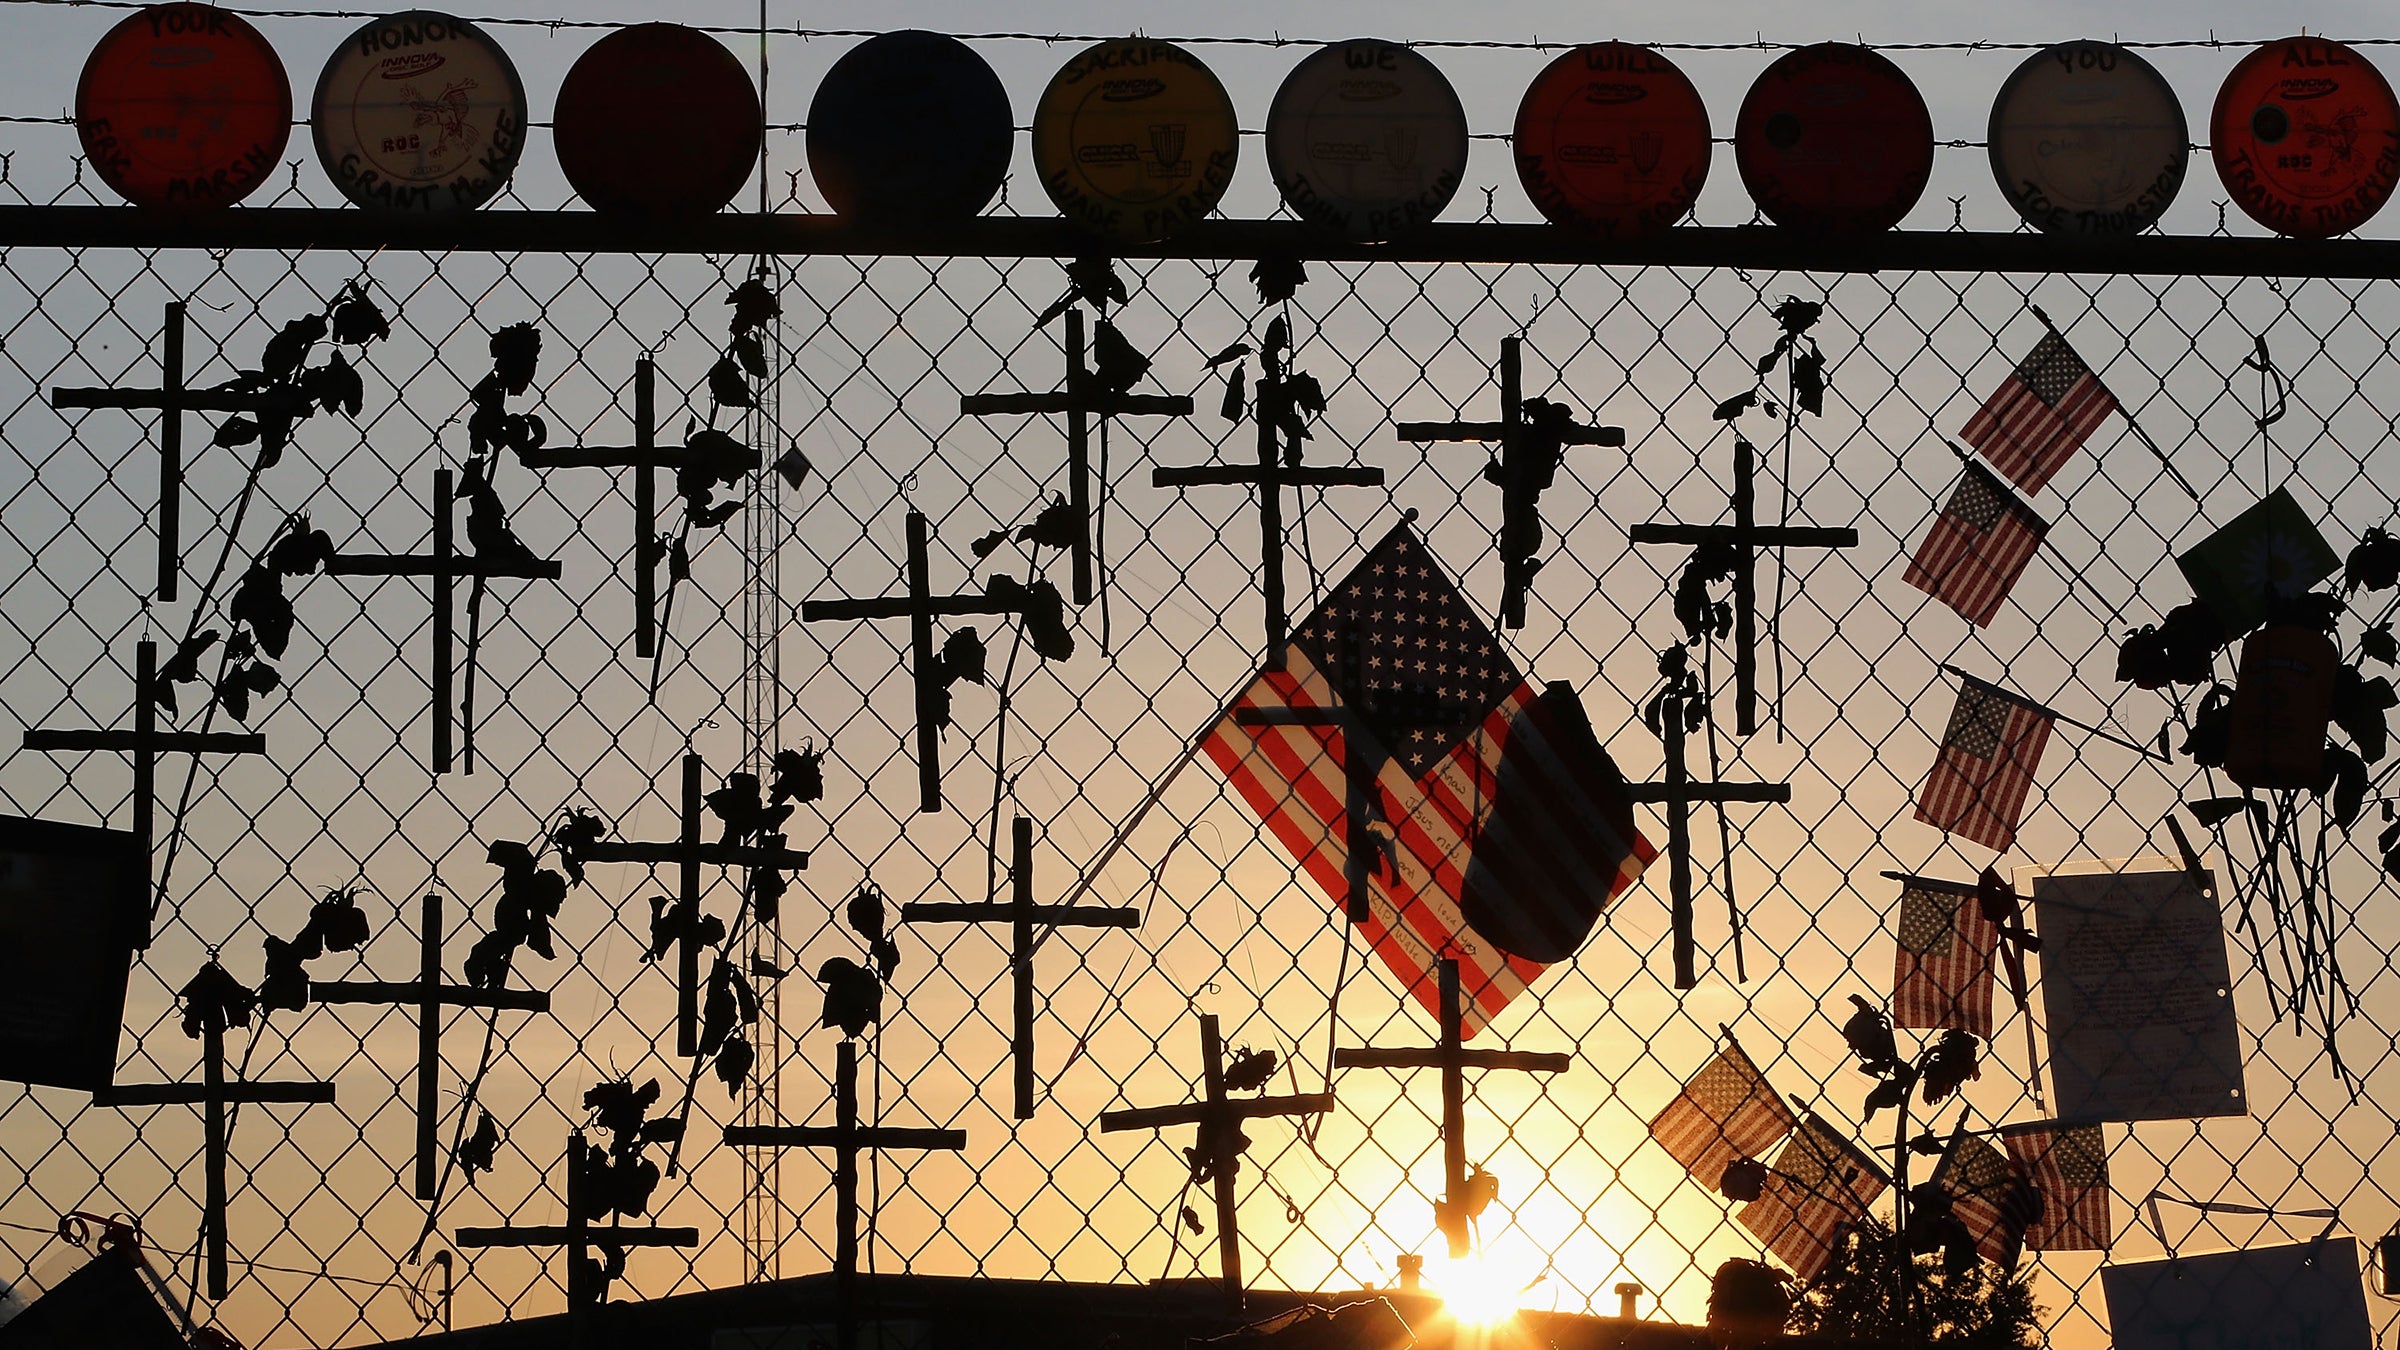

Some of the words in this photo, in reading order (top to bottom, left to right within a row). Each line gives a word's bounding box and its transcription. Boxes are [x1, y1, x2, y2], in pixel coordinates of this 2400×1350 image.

[147, 8, 233, 38] YOUR
[360, 18, 472, 56] HONOR
[381, 52, 437, 67] INNOVA
[1346, 47, 1398, 70] WE
[1584, 48, 1669, 73] WILL
[2057, 49, 2117, 75] YOU
[2281, 44, 2350, 67] ALL
[382, 134, 421, 152] ROC
[167, 143, 271, 206] MARSH
[340, 153, 439, 211] GRANT
[2223, 145, 2303, 224] TRAVIS
[1142, 149, 1234, 237] PARKER
[2012, 178, 2069, 230] JOE
[2077, 153, 2182, 236] THURSTON
